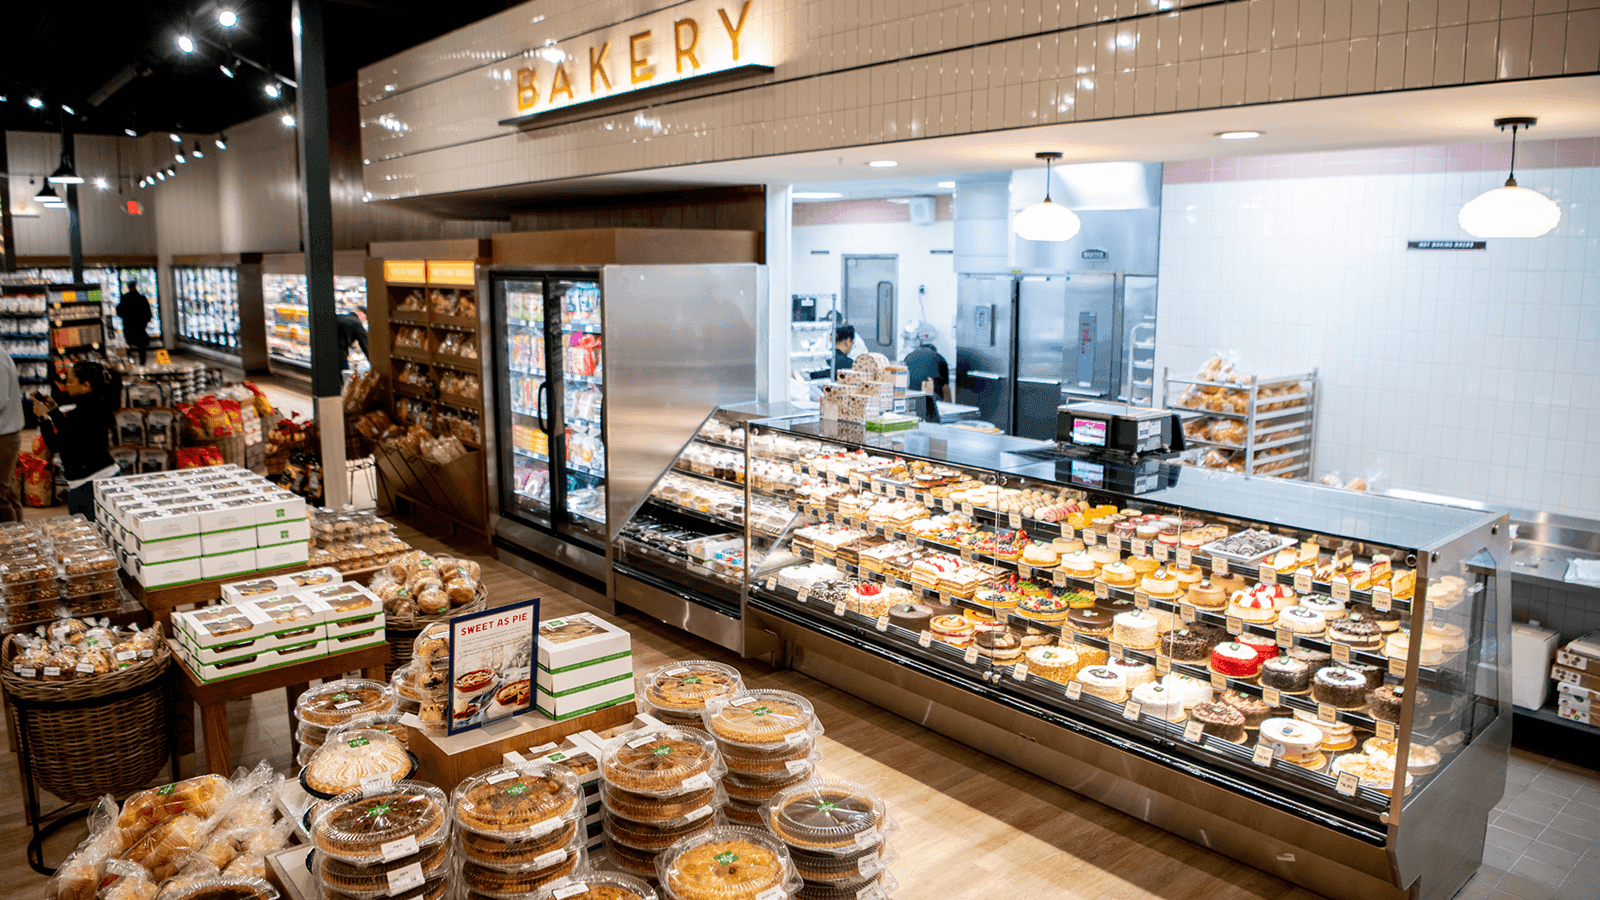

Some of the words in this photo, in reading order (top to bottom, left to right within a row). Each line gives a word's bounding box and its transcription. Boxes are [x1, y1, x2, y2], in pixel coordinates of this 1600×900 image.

[517, 1, 751, 111] BAKERY
[461, 620, 494, 636] SWEET
[497, 617, 510, 627] AS
[512, 612, 528, 623] PIE
